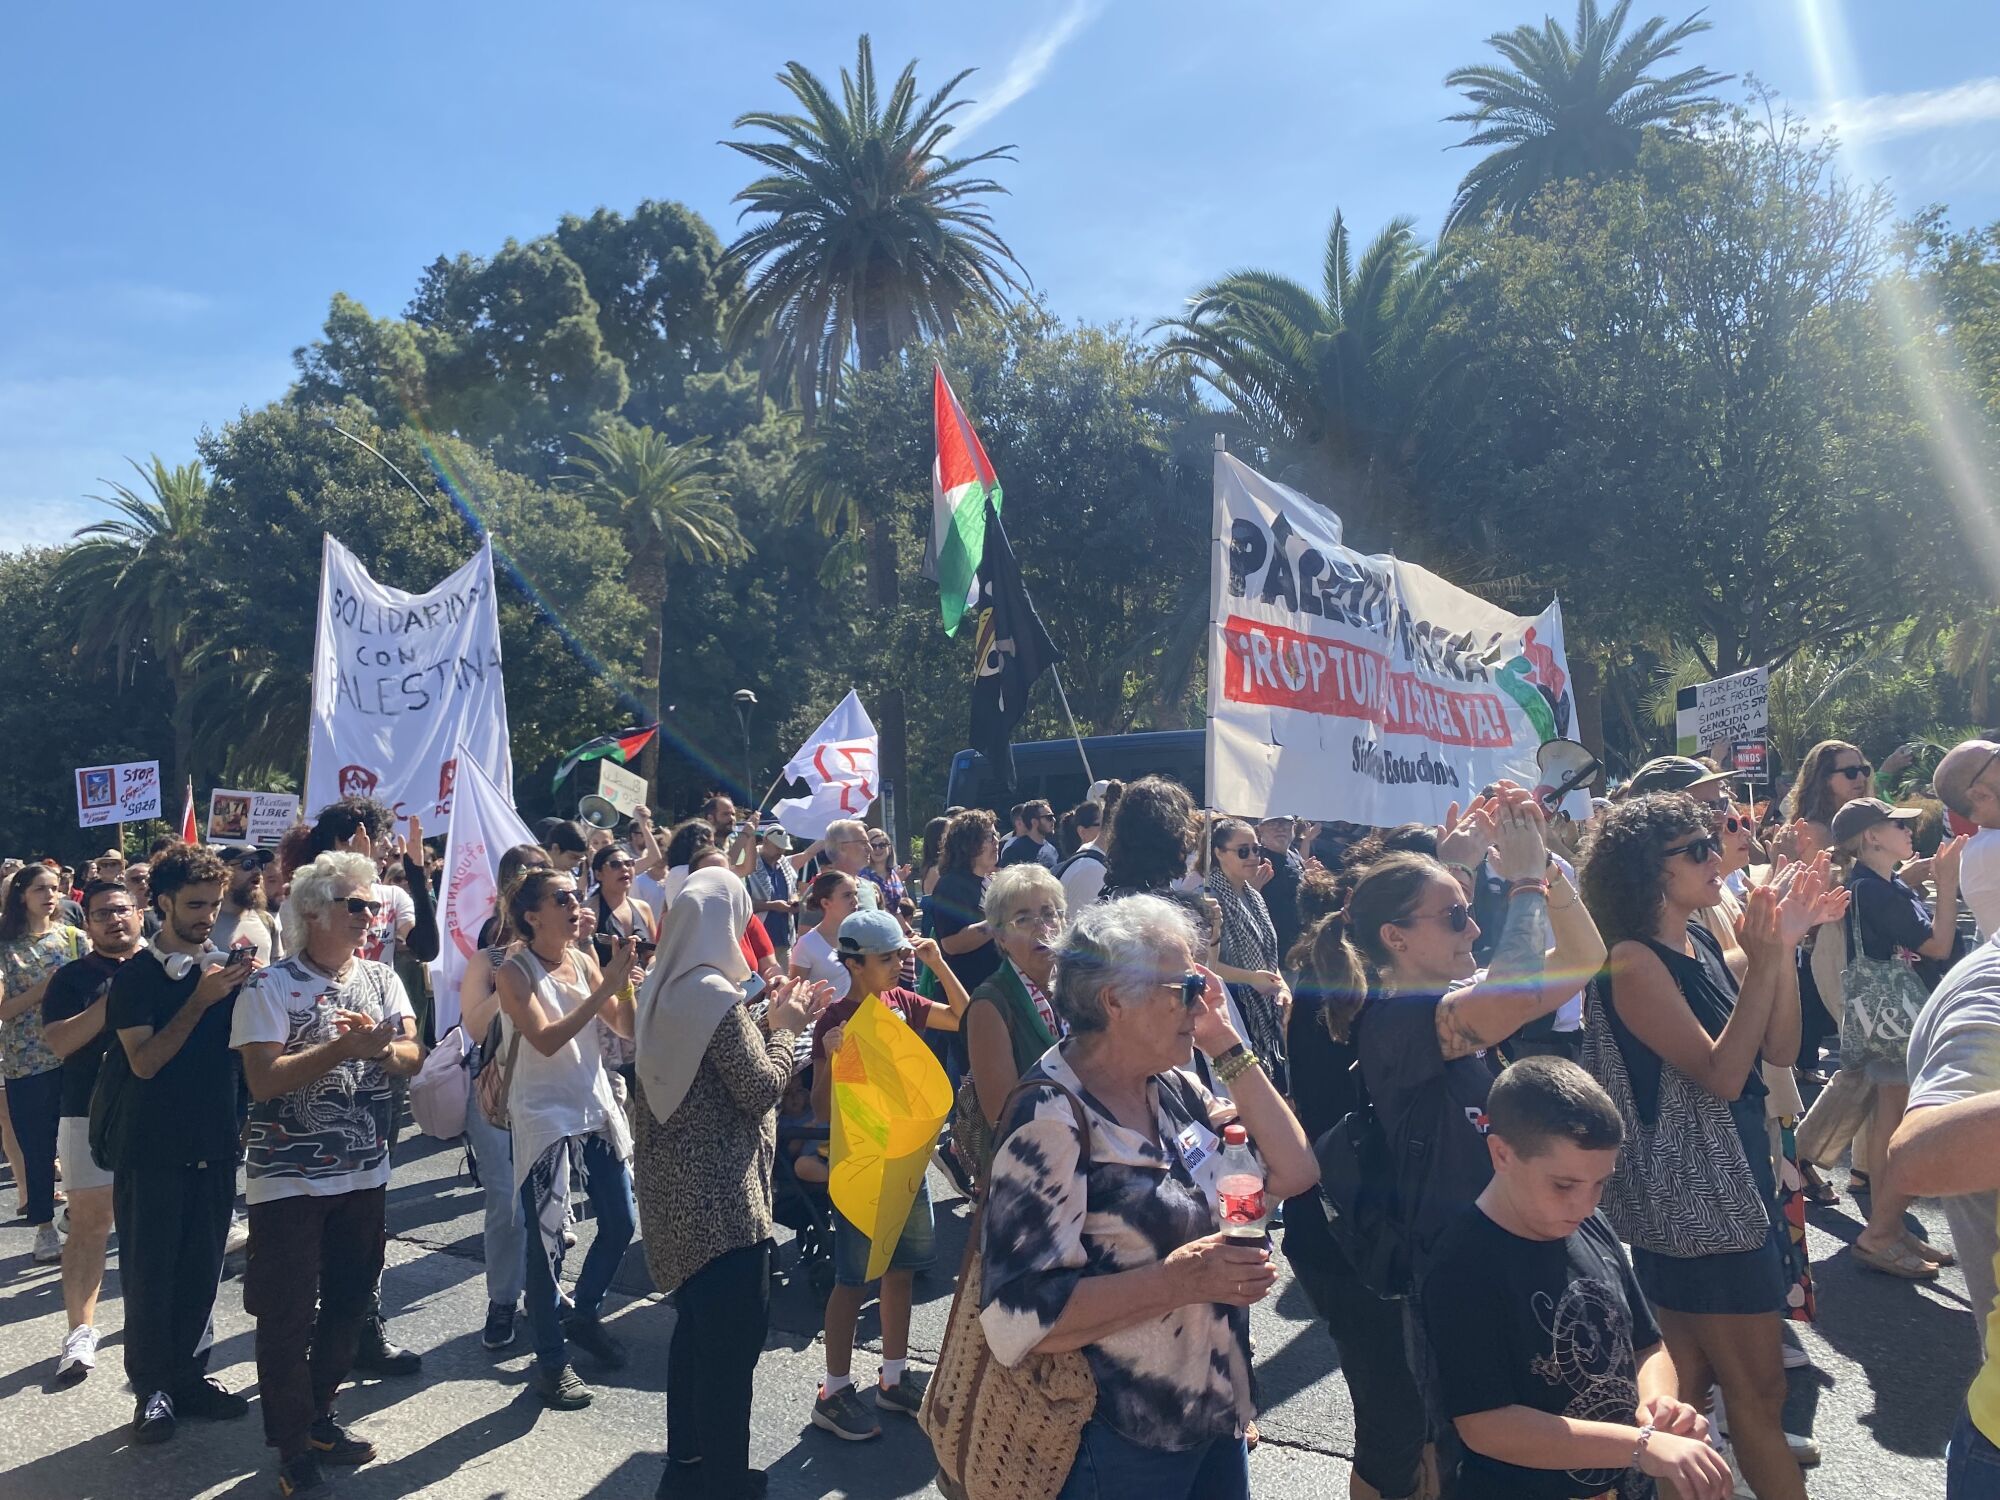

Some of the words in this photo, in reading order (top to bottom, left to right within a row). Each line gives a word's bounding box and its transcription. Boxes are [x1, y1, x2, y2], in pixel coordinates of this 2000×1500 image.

[356, 646, 415, 666] CON
[329, 645, 502, 716] PALESTINA
[1703, 673, 1758, 698] PAREMOS
[1403, 680, 1462, 737] ISRAEL
[1455, 698, 1505, 740] YA!
[1698, 701, 1705, 711] A
[1709, 695, 1726, 707] LOS
[1699, 700, 1749, 724] SIONISTAS
[1751, 694, 1768, 708] STOP
[1699, 714, 1750, 734] GENOCIDIO
[1753, 710, 1761, 719] A
[123, 767, 154, 782] STOP
[253, 808, 290, 817] LIBRE
